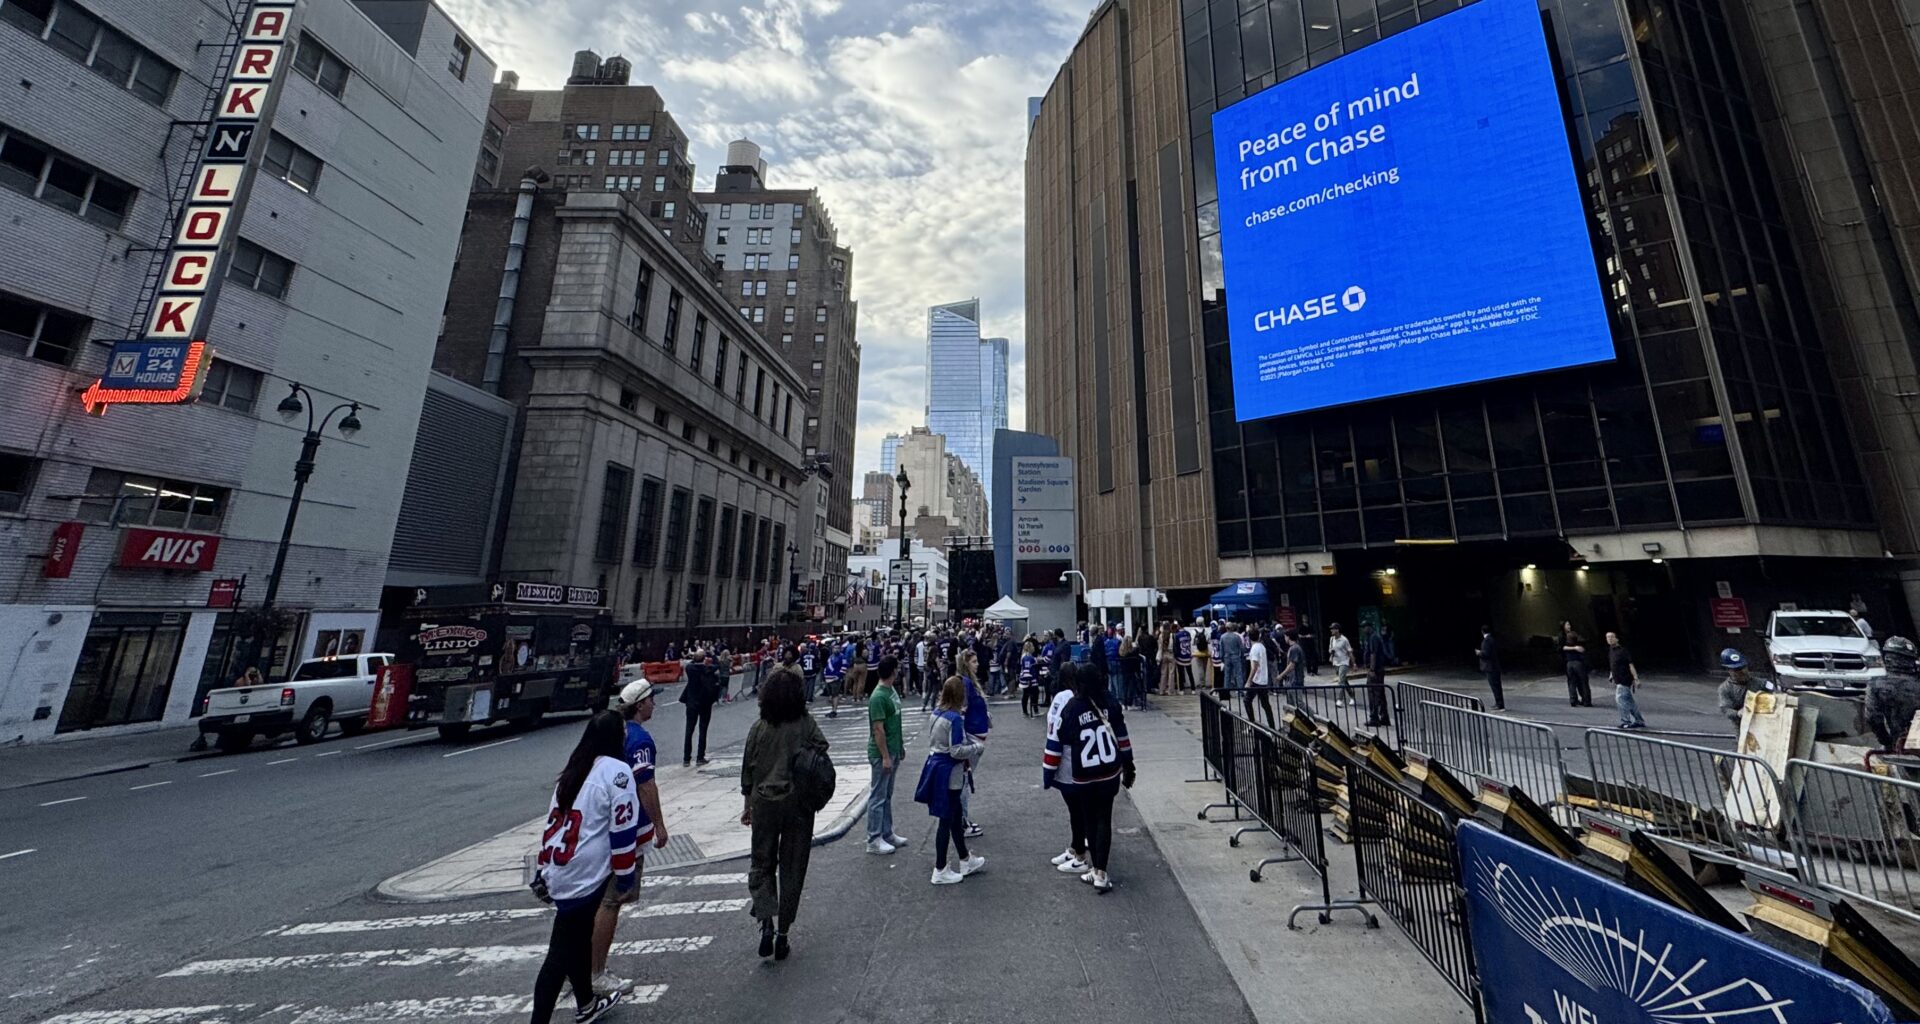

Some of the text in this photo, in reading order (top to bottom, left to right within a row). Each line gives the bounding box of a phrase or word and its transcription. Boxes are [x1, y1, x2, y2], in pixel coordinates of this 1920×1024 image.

[226, 11, 285, 113] ARK
[1239, 72, 1420, 162] Peace of mind
[1240, 123, 1386, 190] from Chase
[1245, 167, 1400, 228] chase.com/checking
[154, 169, 231, 333] LOCK
[1254, 293, 1338, 332] CHASE
[1268, 348, 1298, 359] Contactless
[1298, 342, 1319, 353] Symbol
[1320, 340, 1330, 348] and
[1331, 333, 1364, 345] Contactless
[1365, 327, 1392, 337] Indicator
[1404, 316, 1442, 329] trademarks
[1443, 311, 1466, 322] owned
[1477, 306, 1491, 315] and
[1492, 302, 1510, 312] used
[1511, 299, 1527, 308] with
[1528, 296, 1542, 304] the
[1327, 344, 1347, 353] Screen
[1347, 340, 1368, 350] images
[1401, 329, 1422, 338] Chase
[1450, 320, 1464, 328] app
[1471, 312, 1503, 324] available
[1503, 309, 1515, 318] for
[1516, 305, 1538, 315] select
[148, 347, 180, 358] OPEN
[1299, 357, 1323, 367] Message
[1324, 353, 1335, 361] and
[1335, 351, 1349, 359] data
[1349, 348, 1364, 356] rates
[1365, 345, 1378, 353] may
[1398, 335, 1430, 348] JPMorgan
[1430, 331, 1451, 340] Chase
[1489, 317, 1519, 328] Member
[135, 372, 177, 383] HOURS
[146, 359, 173, 371] 24
[1302, 365, 1320, 373] Chase
[52, 537, 68, 562] AVIS
[141, 537, 206, 565] AVIS
[516, 582, 599, 604] MEXICO LINDO
[418, 626, 487, 645] MEXICO
[424, 640, 479, 650] LINDO
[803, 659, 813, 671] 31
[634, 748, 651, 764] 31
[1080, 725, 1116, 768] 20
[615, 801, 634, 825] 23
[538, 807, 583, 866] 23
